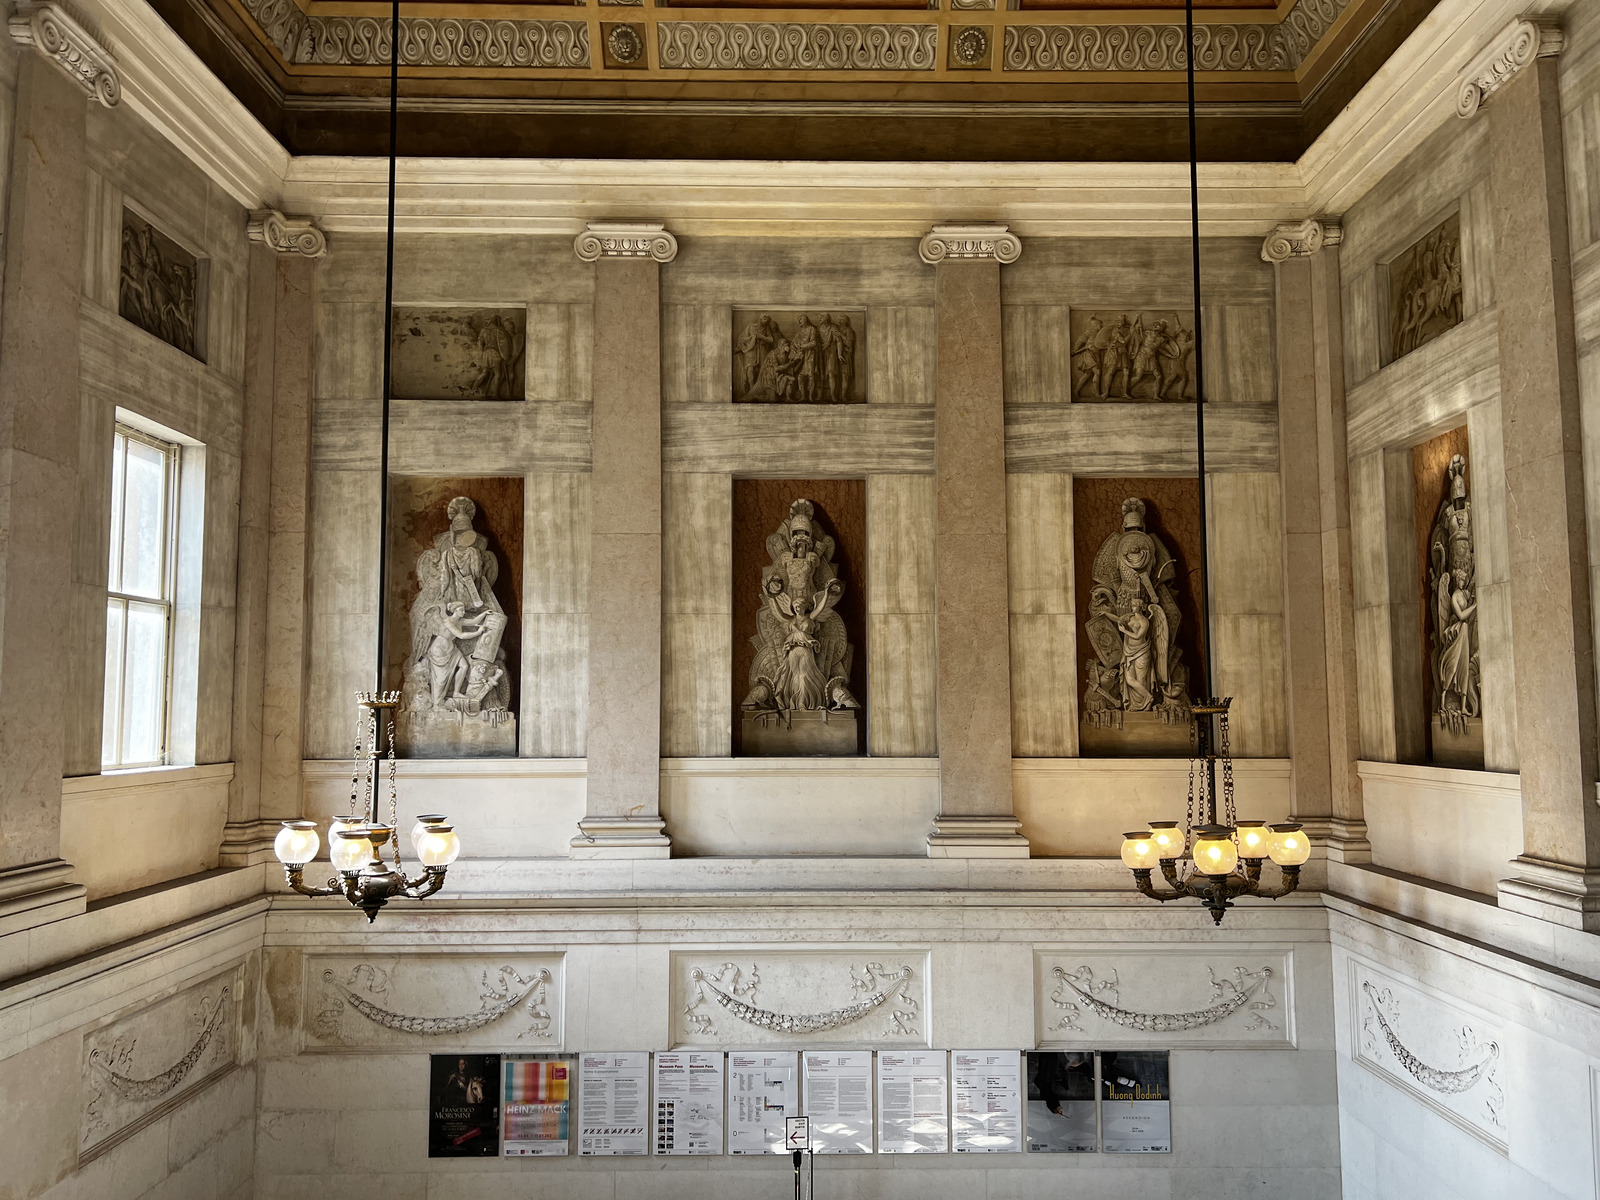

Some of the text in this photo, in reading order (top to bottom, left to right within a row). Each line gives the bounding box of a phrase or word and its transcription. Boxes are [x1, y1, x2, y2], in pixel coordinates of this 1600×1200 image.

[1109, 1084, 1162, 1109] Huong Dodinh
[506, 1105, 567, 1114] HEINZ MACK
[434, 1111, 471, 1119] MOROSINI
